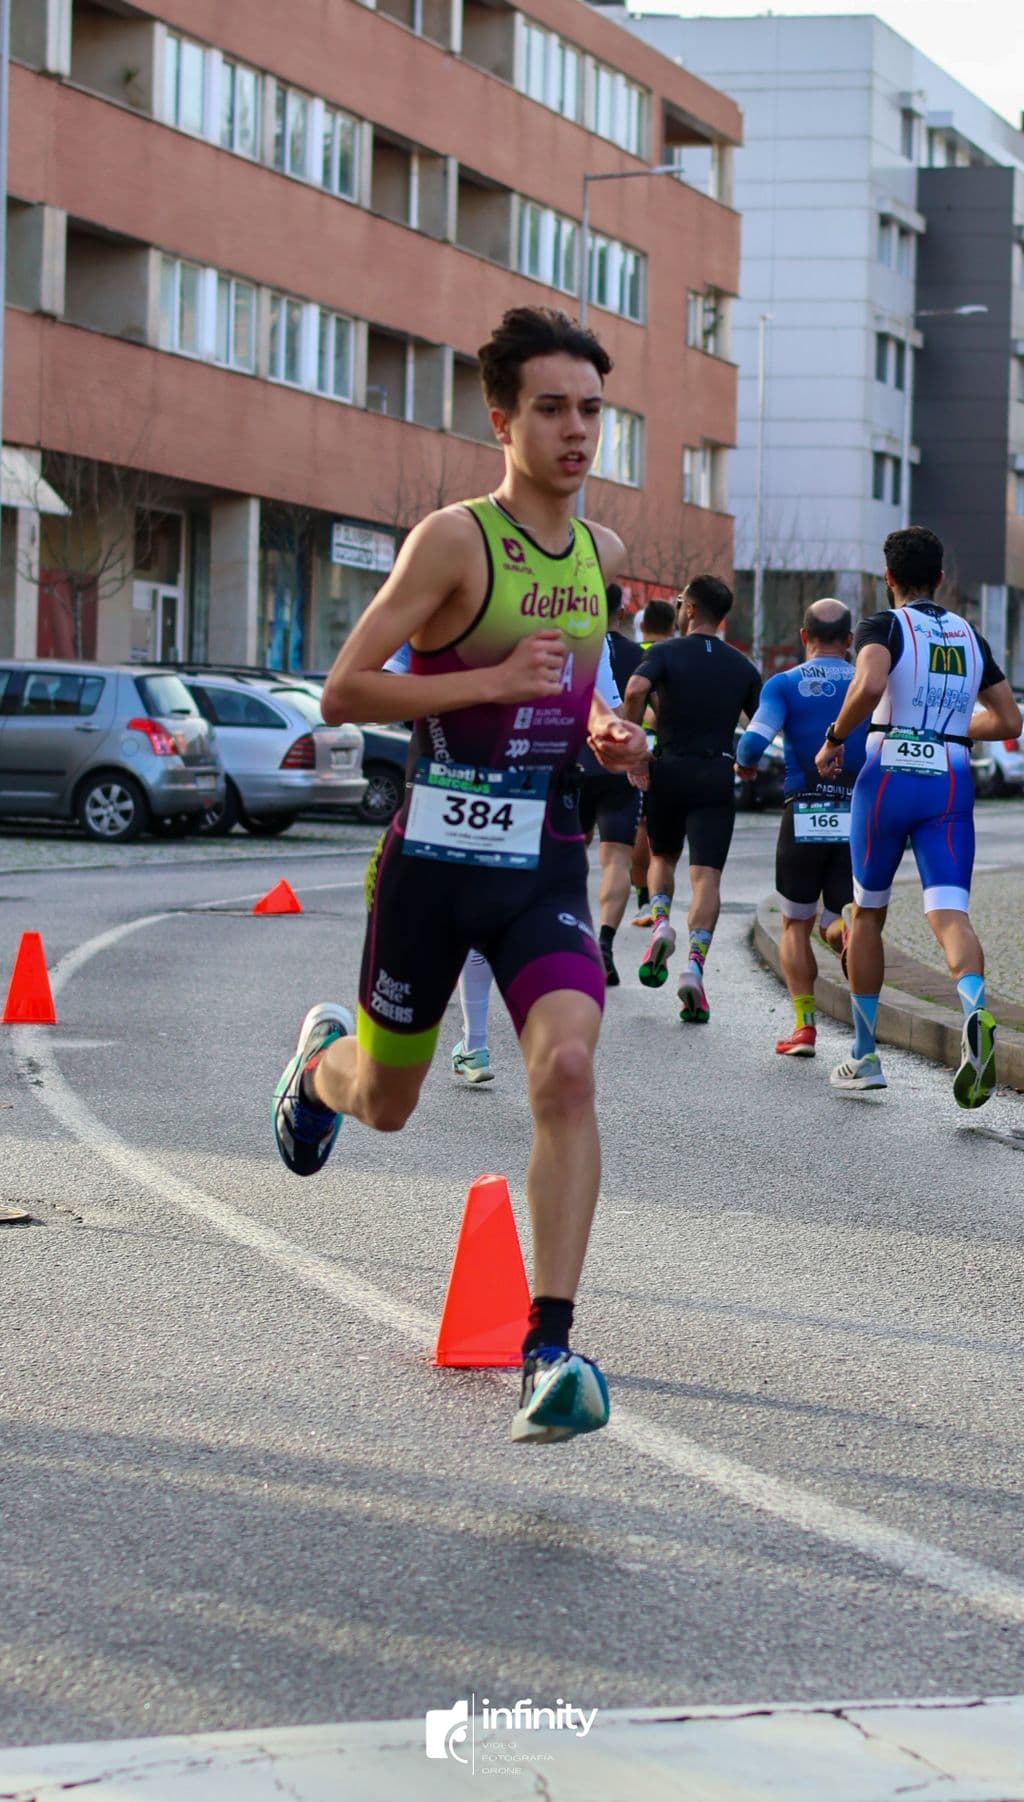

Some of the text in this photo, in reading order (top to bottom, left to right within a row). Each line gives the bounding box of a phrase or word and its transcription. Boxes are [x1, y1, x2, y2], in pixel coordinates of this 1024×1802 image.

[520, 581, 600, 619] delikia
[897, 742, 935, 758] 430
[442, 796, 513, 832] 384
[809, 814, 839, 828] 166
